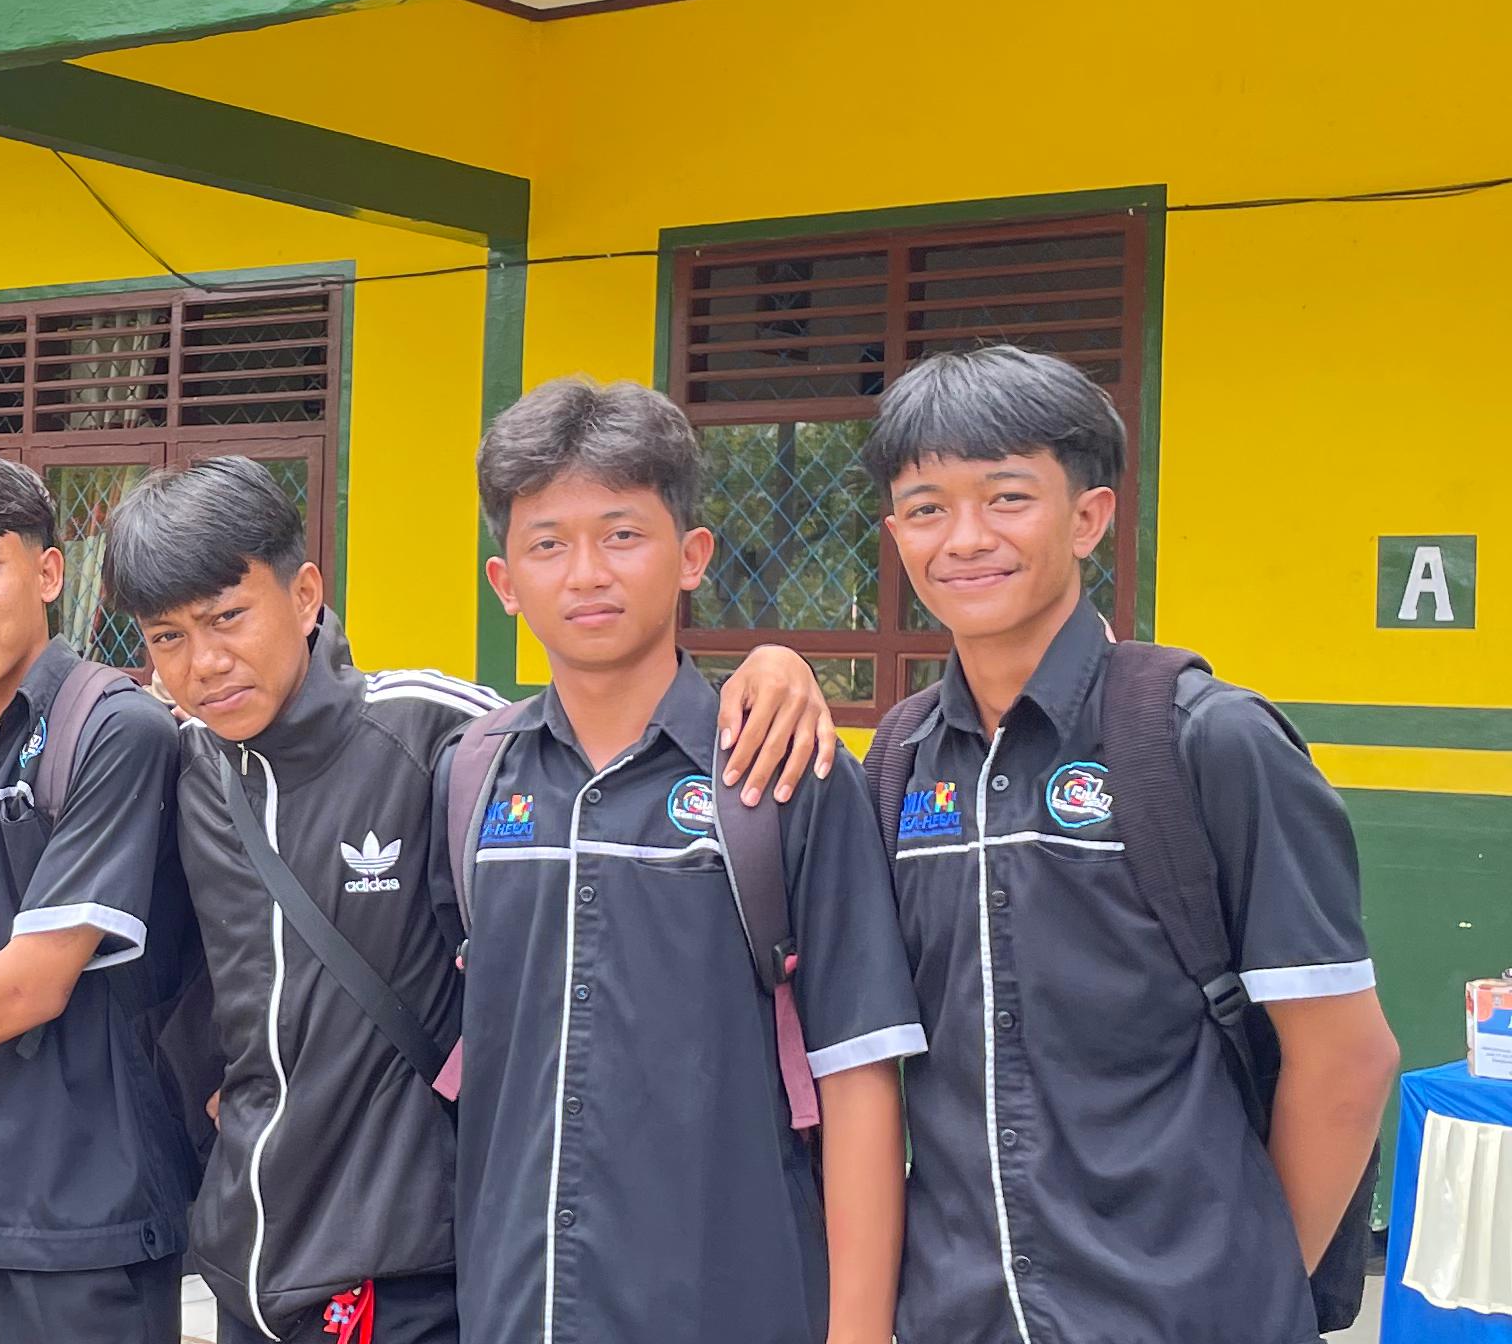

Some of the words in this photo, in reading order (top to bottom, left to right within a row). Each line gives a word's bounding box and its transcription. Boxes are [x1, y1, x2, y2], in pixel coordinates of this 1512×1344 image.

[1398, 546, 1455, 622] A
[900, 790, 934, 815] MK
[344, 877, 401, 893] adidas
